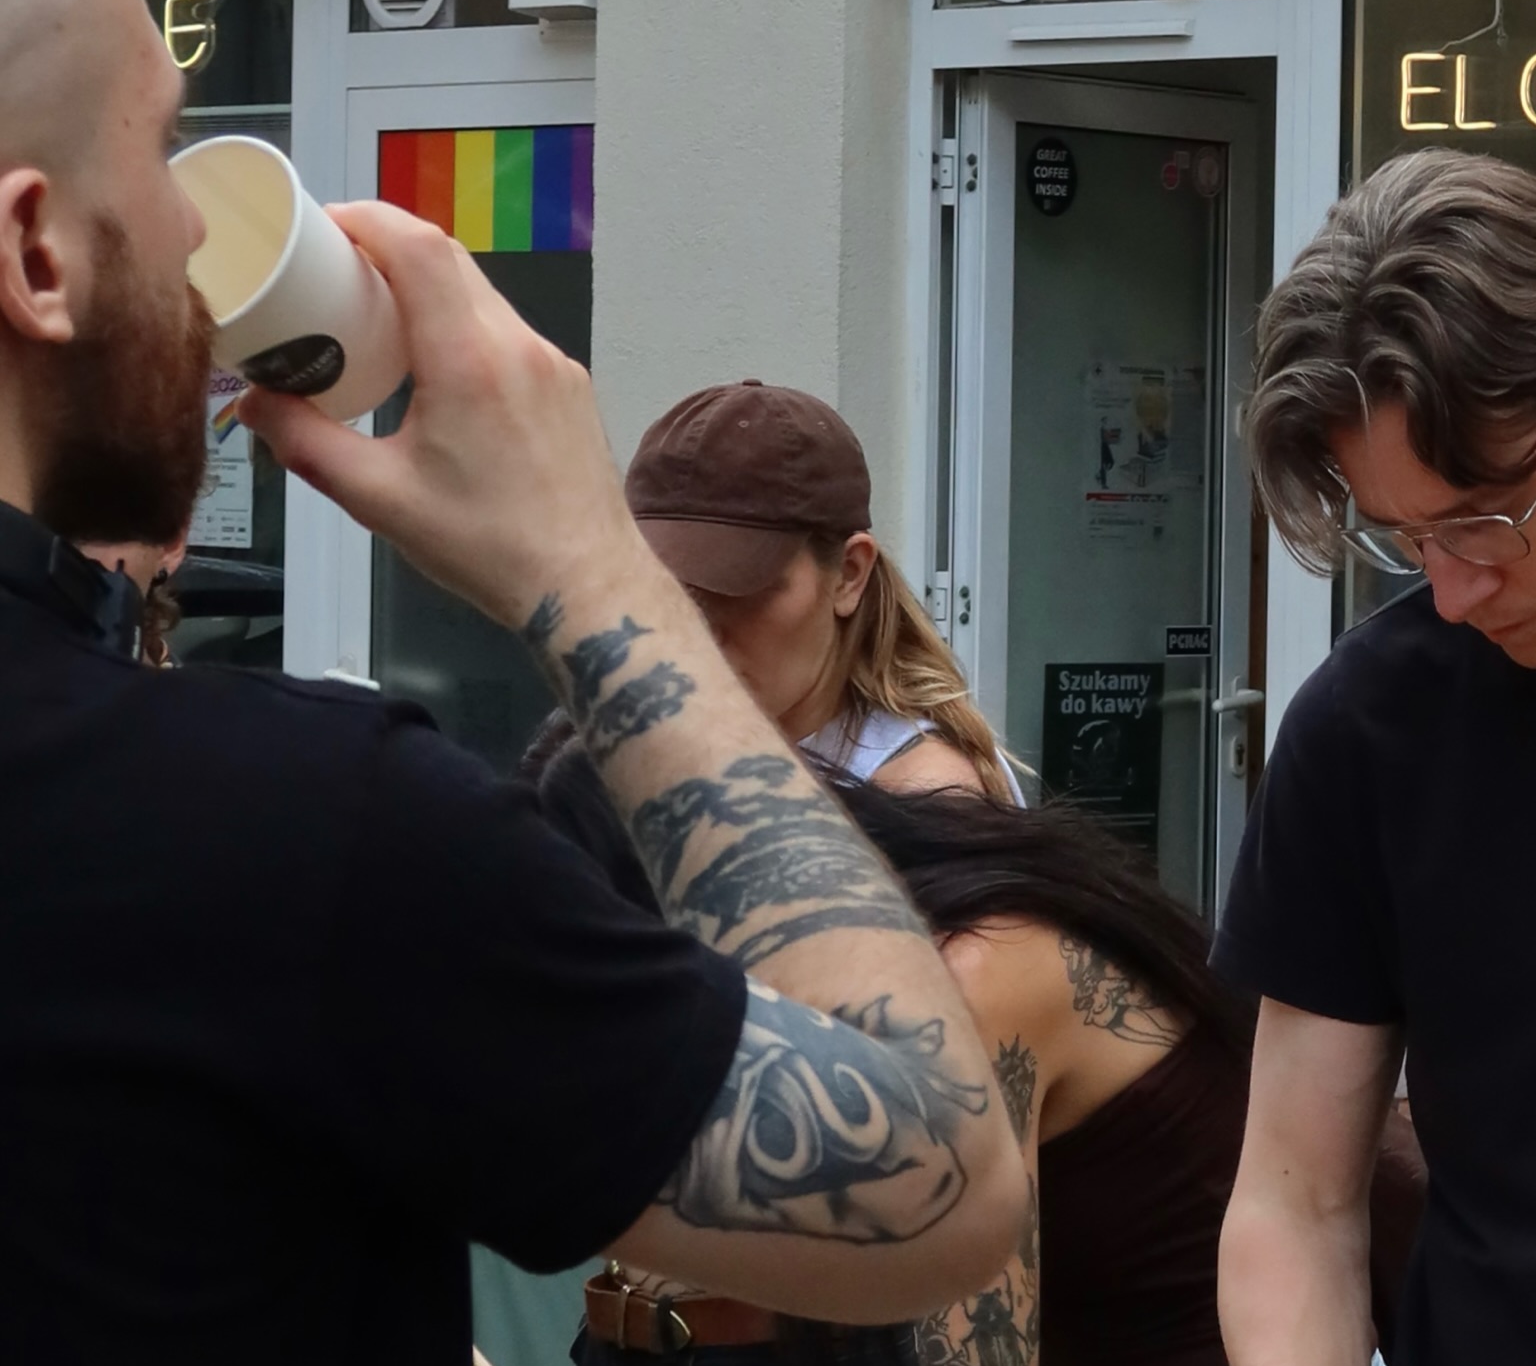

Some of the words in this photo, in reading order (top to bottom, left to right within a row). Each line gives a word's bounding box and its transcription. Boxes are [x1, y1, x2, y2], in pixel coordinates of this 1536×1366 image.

[1400, 51, 1497, 131] EL
[1036, 148, 1068, 162] GREAT
[1033, 165, 1070, 180] COFFEE
[1035, 183, 1068, 197] INSIDE
[1058, 670, 1151, 695] Szukamy
[1060, 694, 1087, 715] do
[1091, 693, 1148, 719] kawy
